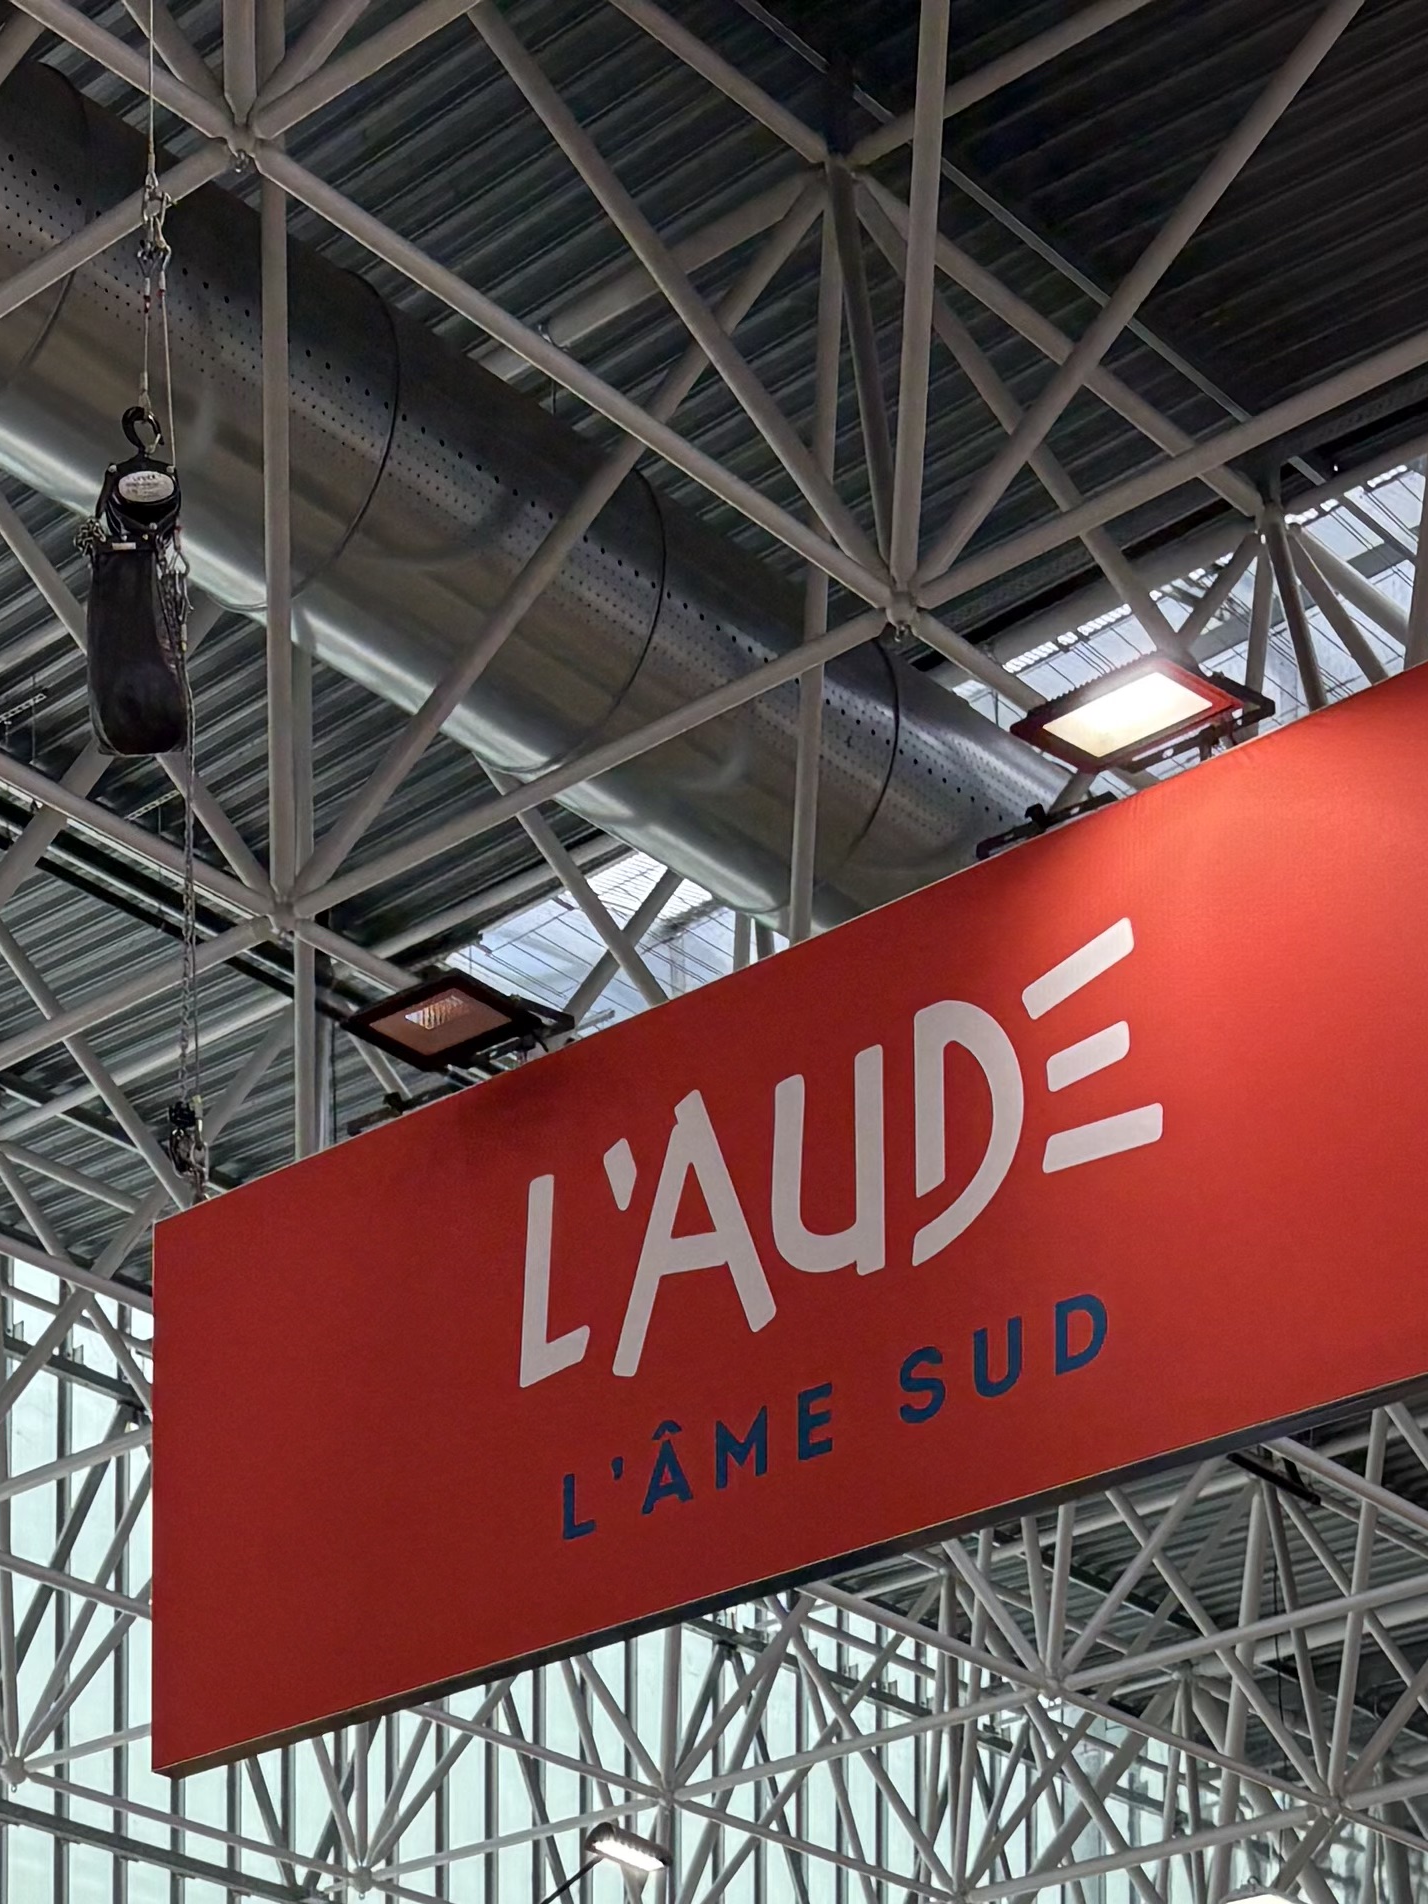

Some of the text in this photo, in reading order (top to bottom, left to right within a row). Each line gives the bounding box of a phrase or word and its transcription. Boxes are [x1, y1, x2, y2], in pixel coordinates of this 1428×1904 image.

[519, 918, 1164, 1389] L'AUDE
[561, 1293, 1109, 1542] L'ÂME SUD
